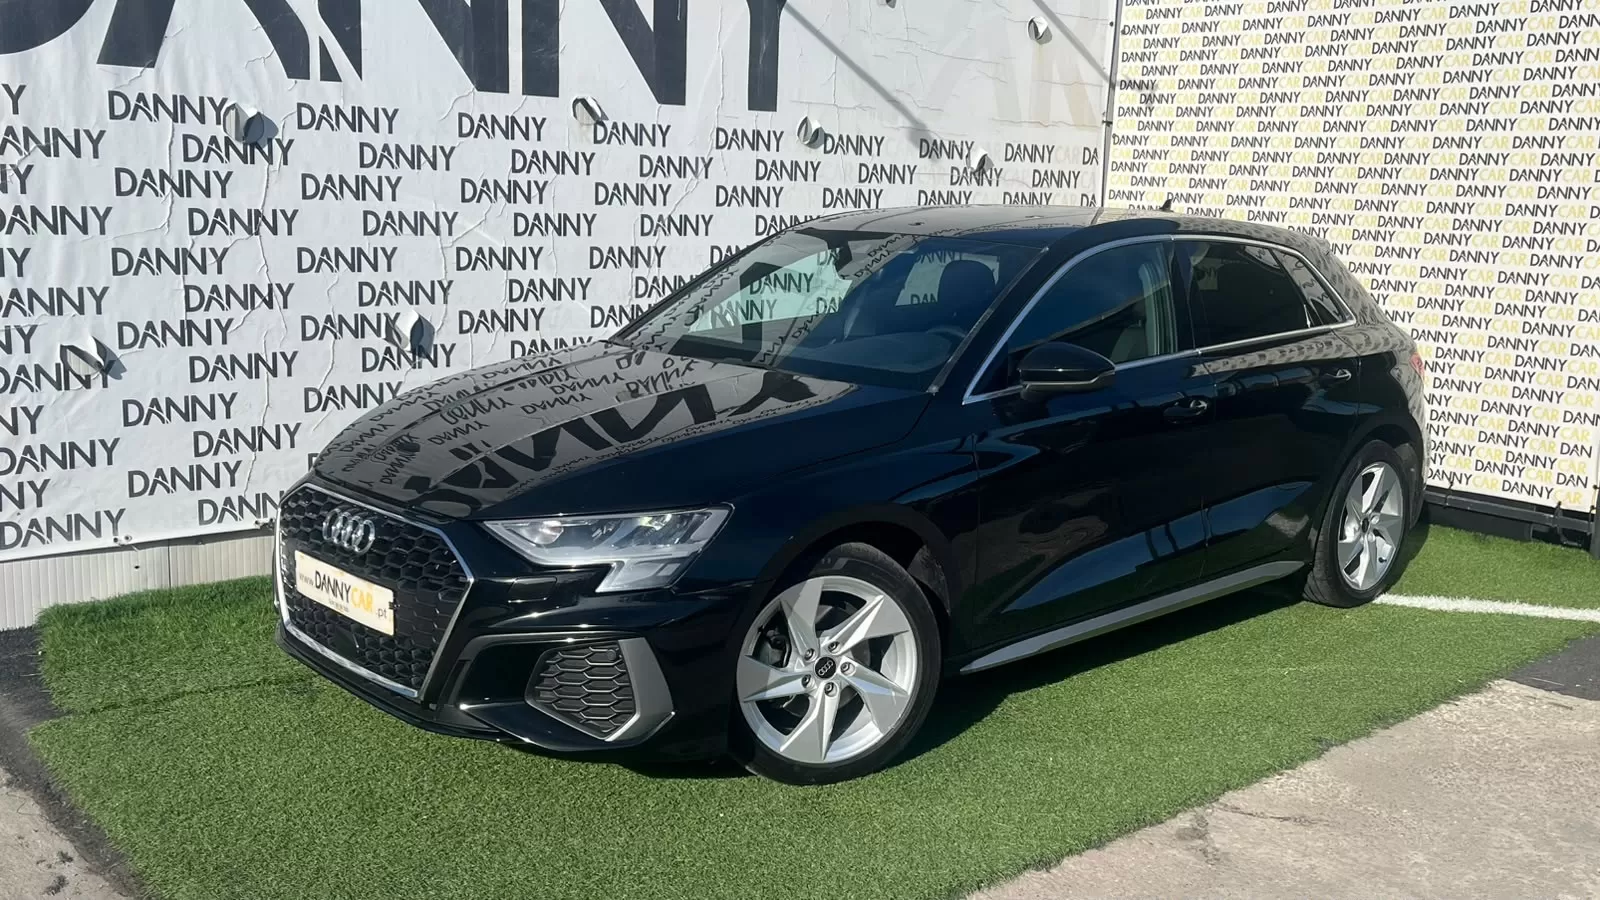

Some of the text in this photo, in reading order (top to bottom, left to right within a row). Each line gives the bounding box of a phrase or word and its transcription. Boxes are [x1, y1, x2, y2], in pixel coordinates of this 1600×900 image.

[108, 90, 228, 125] DANNY
[297, 103, 399, 134] DANNY
[458, 112, 546, 141] DANNY
[593, 120, 671, 147] DANNY
[715, 127, 784, 152] DANNY
[182, 133, 295, 166] DANNY
[359, 142, 456, 171] DANNY
[823, 133, 885, 157] DANNY
[509, 149, 595, 175] DANNY
[640, 155, 713, 179] DANNY
[756, 159, 821, 182] DANNY
[859, 164, 917, 185] DANNY
[115, 167, 234, 199] DANNY
[301, 173, 402, 201] DANNY
[461, 178, 548, 204] DANNY
[595, 182, 671, 206] DANNY
[716, 185, 784, 208] DANNY
[823, 188, 883, 209] DANNY
[188, 207, 299, 237] DANNY
[363, 210, 458, 236] DANNY
[514, 213, 597, 236] DANNY
[641, 214, 713, 236] DANNY
[111, 247, 230, 277] DANNY
[297, 247, 397, 273] DANNY
[456, 247, 543, 271] DANNY
[590, 246, 666, 269] DANNY
[184, 283, 295, 313] DANNY
[358, 280, 453, 307] DANNY
[505, 278, 592, 302] DANNY
[117, 317, 234, 350] DANNY
[459, 308, 545, 334] DANNY
[189, 351, 298, 384] DANNY
[123, 392, 238, 427] DANNY
[193, 422, 302, 458] DANNY
[128, 460, 242, 498] DANNY
[0, 508, 126, 550] DANNY
